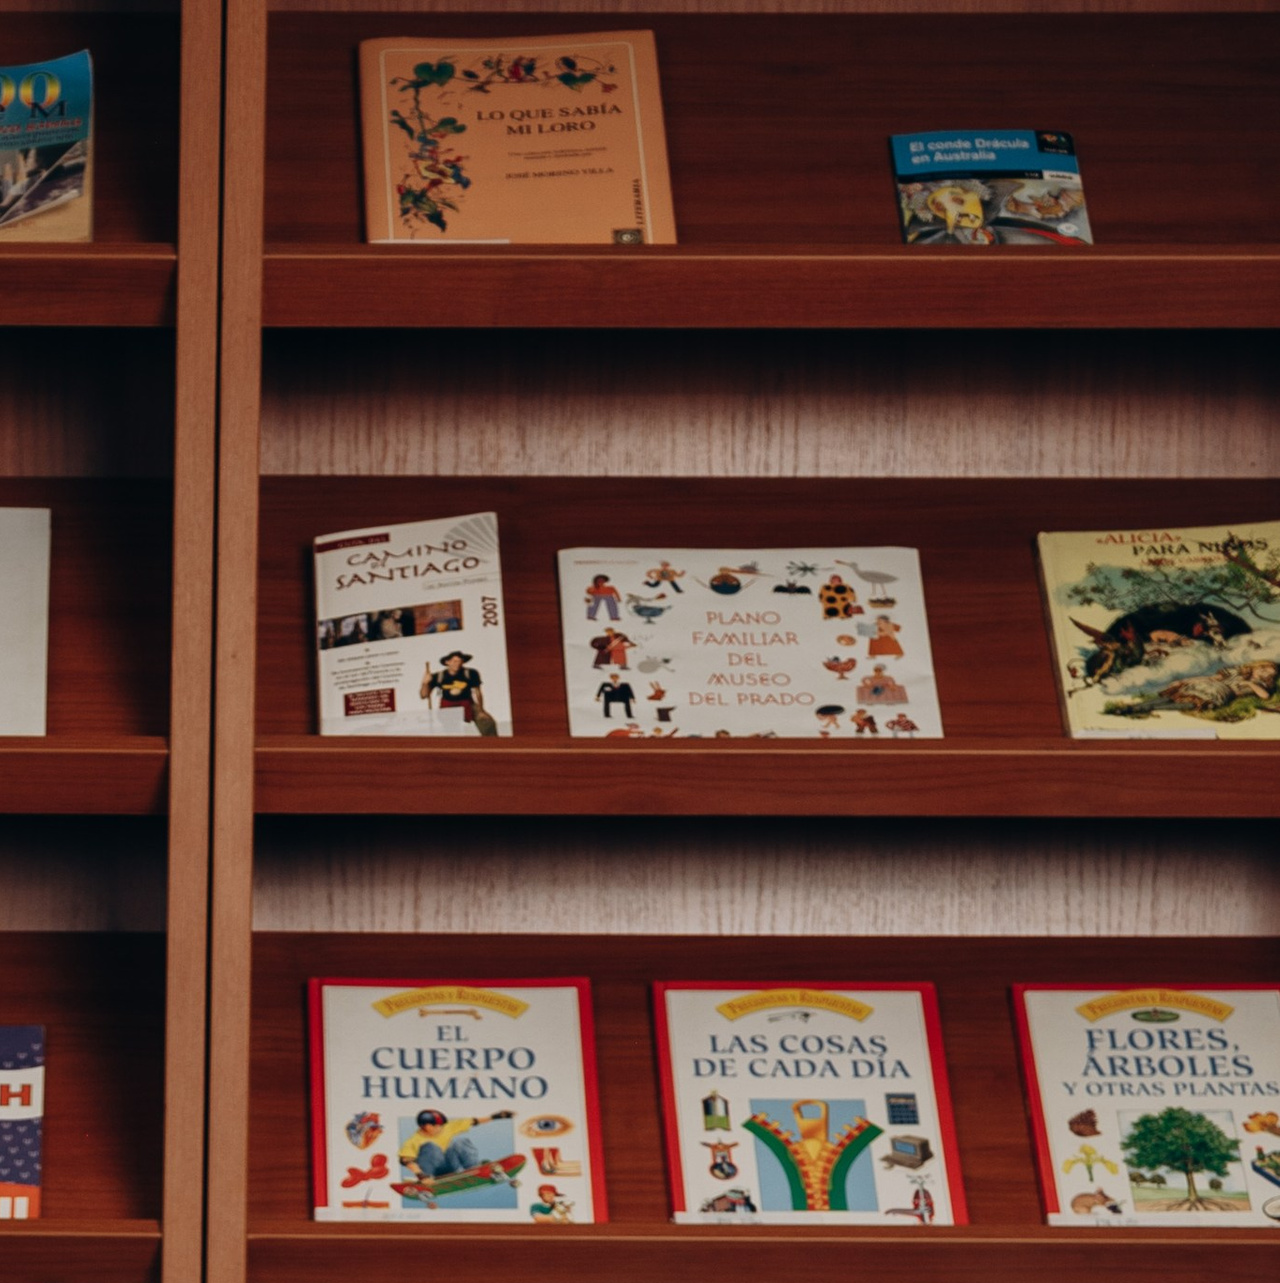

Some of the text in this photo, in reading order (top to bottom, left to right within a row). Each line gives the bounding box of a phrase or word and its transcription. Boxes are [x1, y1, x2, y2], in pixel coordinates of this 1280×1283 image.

[476, 102, 622, 122] LO QUE SABÍA
[506, 120, 596, 135] MI LORO
[909, 137, 1030, 152] El conde Drácula
[911, 150, 996, 164] en Australia
[346, 539, 468, 568] CAMINO
[1131, 542, 1190, 556] PARA
[334, 556, 480, 591] SANTIAGO
[481, 595, 498, 627] 2007
[706, 610, 782, 626] PLANO
[691, 630, 800, 646] FAMILIAR
[727, 651, 768, 667] DEL
[707, 672, 792, 687] MUSEO
[688, 691, 816, 706] DEL PRADO
[436, 1025, 468, 1042] EL
[1085, 1028, 1240, 1053] FLORES,
[709, 1034, 888, 1055] LAS COSAS
[370, 1047, 536, 1071] CUERPO
[692, 1054, 911, 1079] DE CADA DÍA
[1082, 1048, 1255, 1078] ÁRBOLES
[361, 1075, 549, 1100] HUMANO
[1062, 1081, 1280, 1097] Y OTRAS PLANTAS
